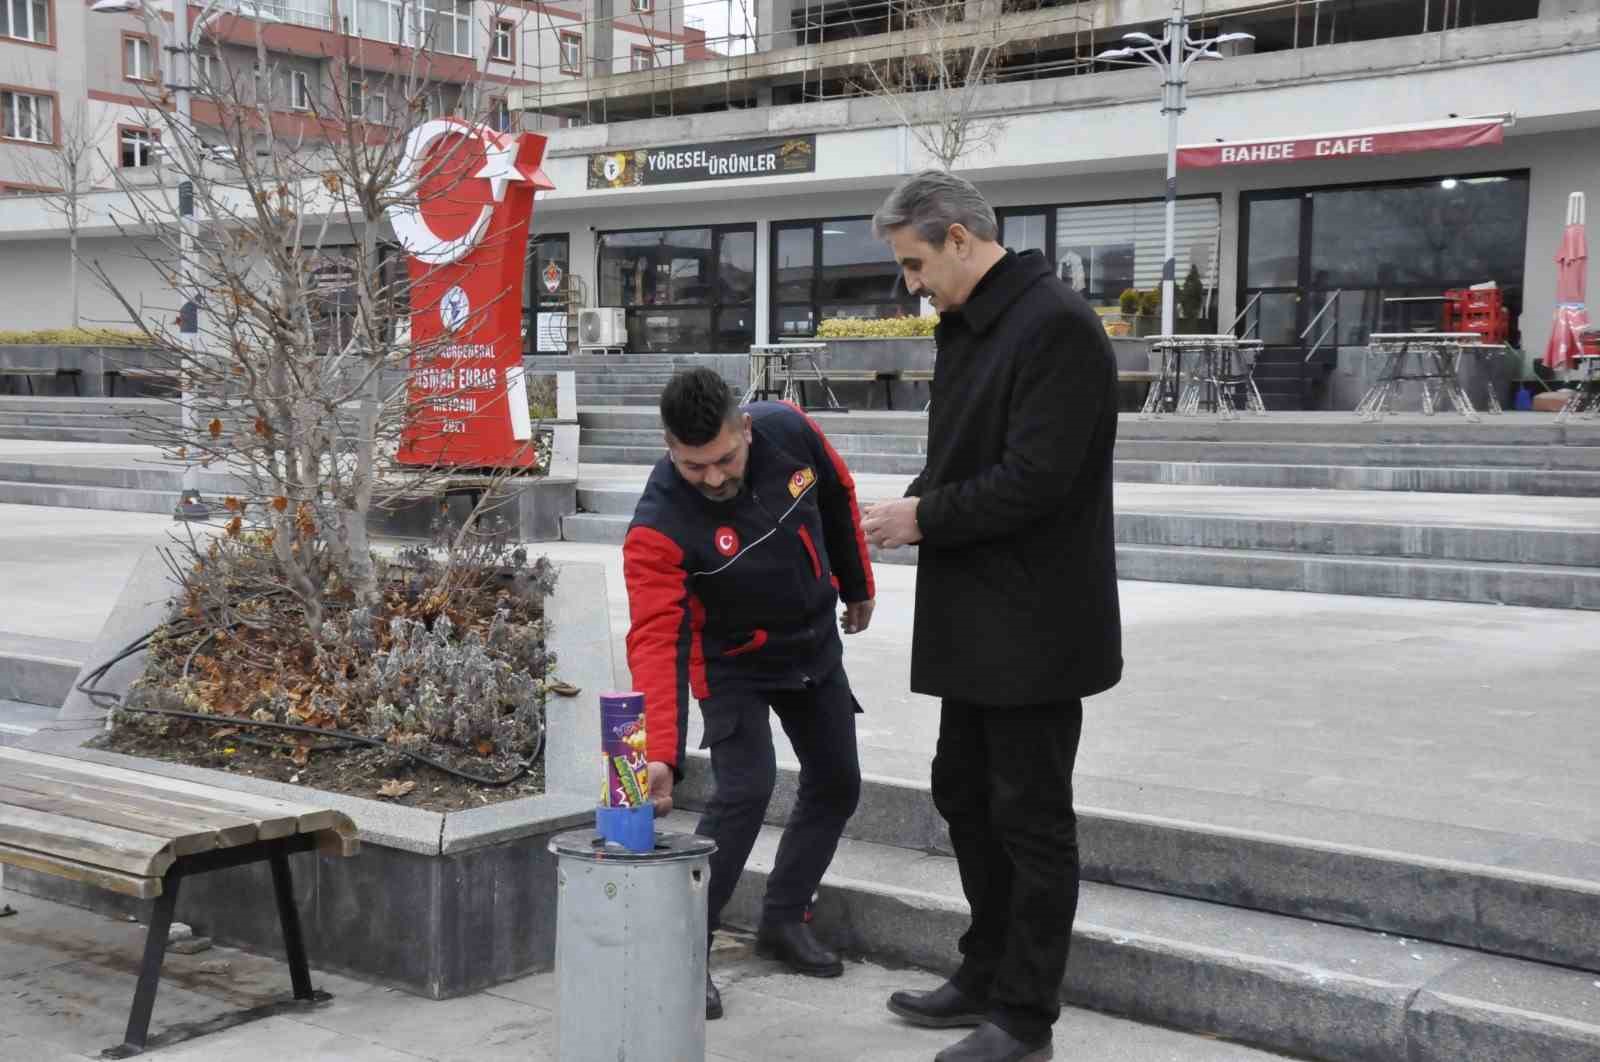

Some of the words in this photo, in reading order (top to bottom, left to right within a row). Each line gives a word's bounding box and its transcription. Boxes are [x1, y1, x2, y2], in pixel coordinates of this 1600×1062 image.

[1315, 137, 1374, 156] CAFE
[648, 150, 709, 171] YÖRESEL
[708, 153, 776, 175] ÜRÜNLER
